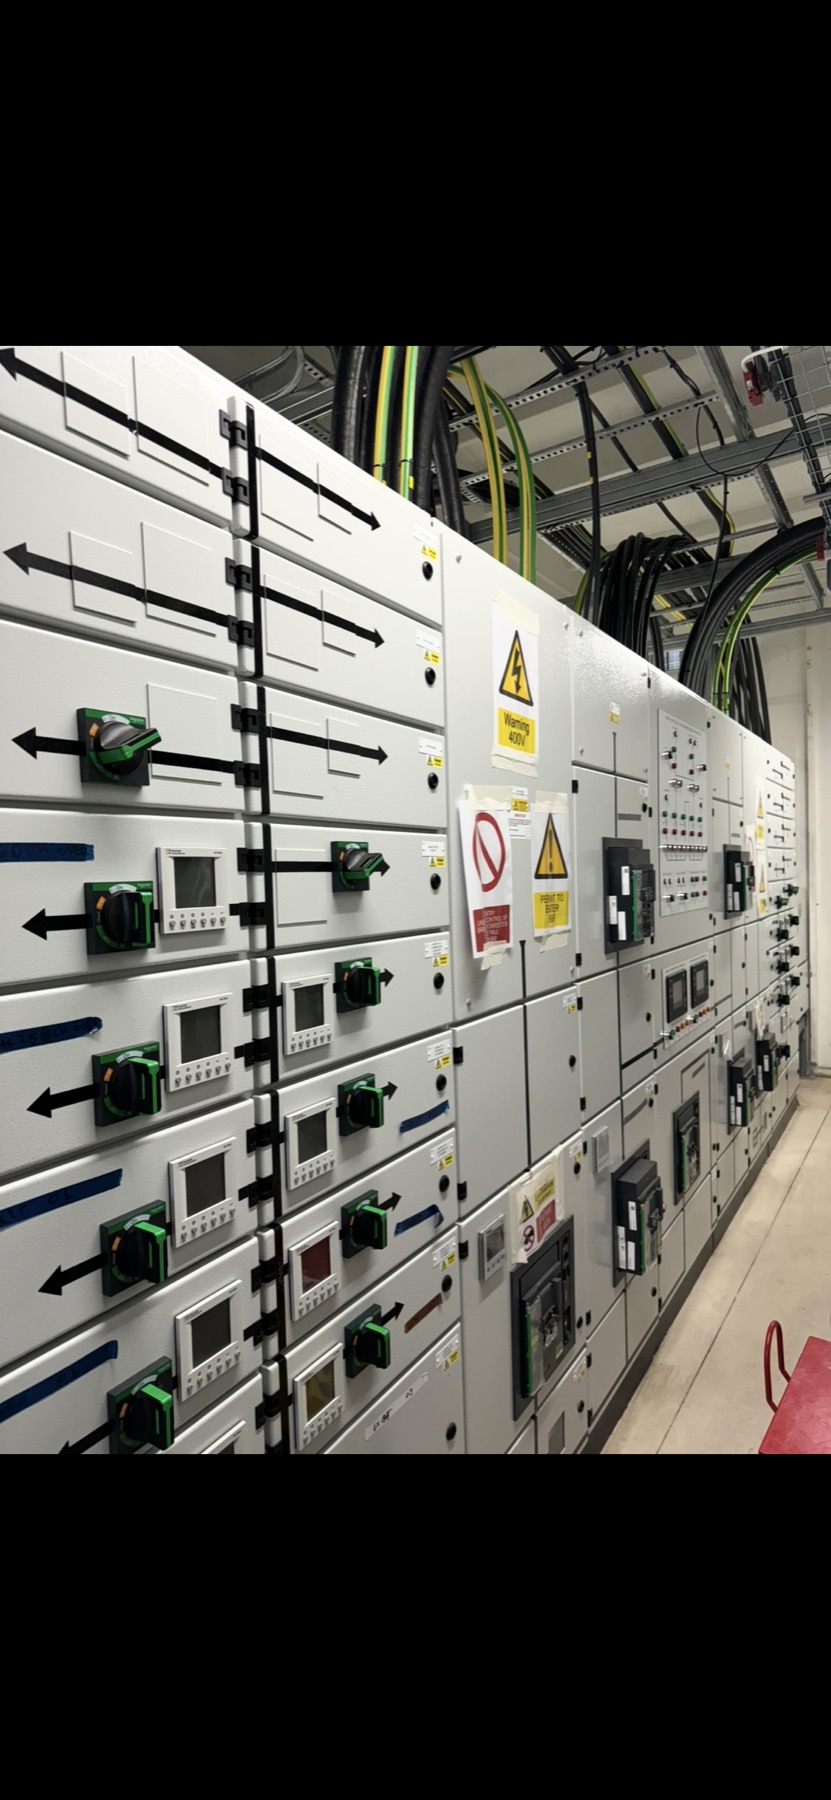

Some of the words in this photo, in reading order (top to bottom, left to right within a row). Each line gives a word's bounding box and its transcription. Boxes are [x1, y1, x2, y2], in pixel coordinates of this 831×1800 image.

[503, 711, 529, 736] Warning
[509, 730, 526, 747] 400V
[556, 893, 564, 902] TO
